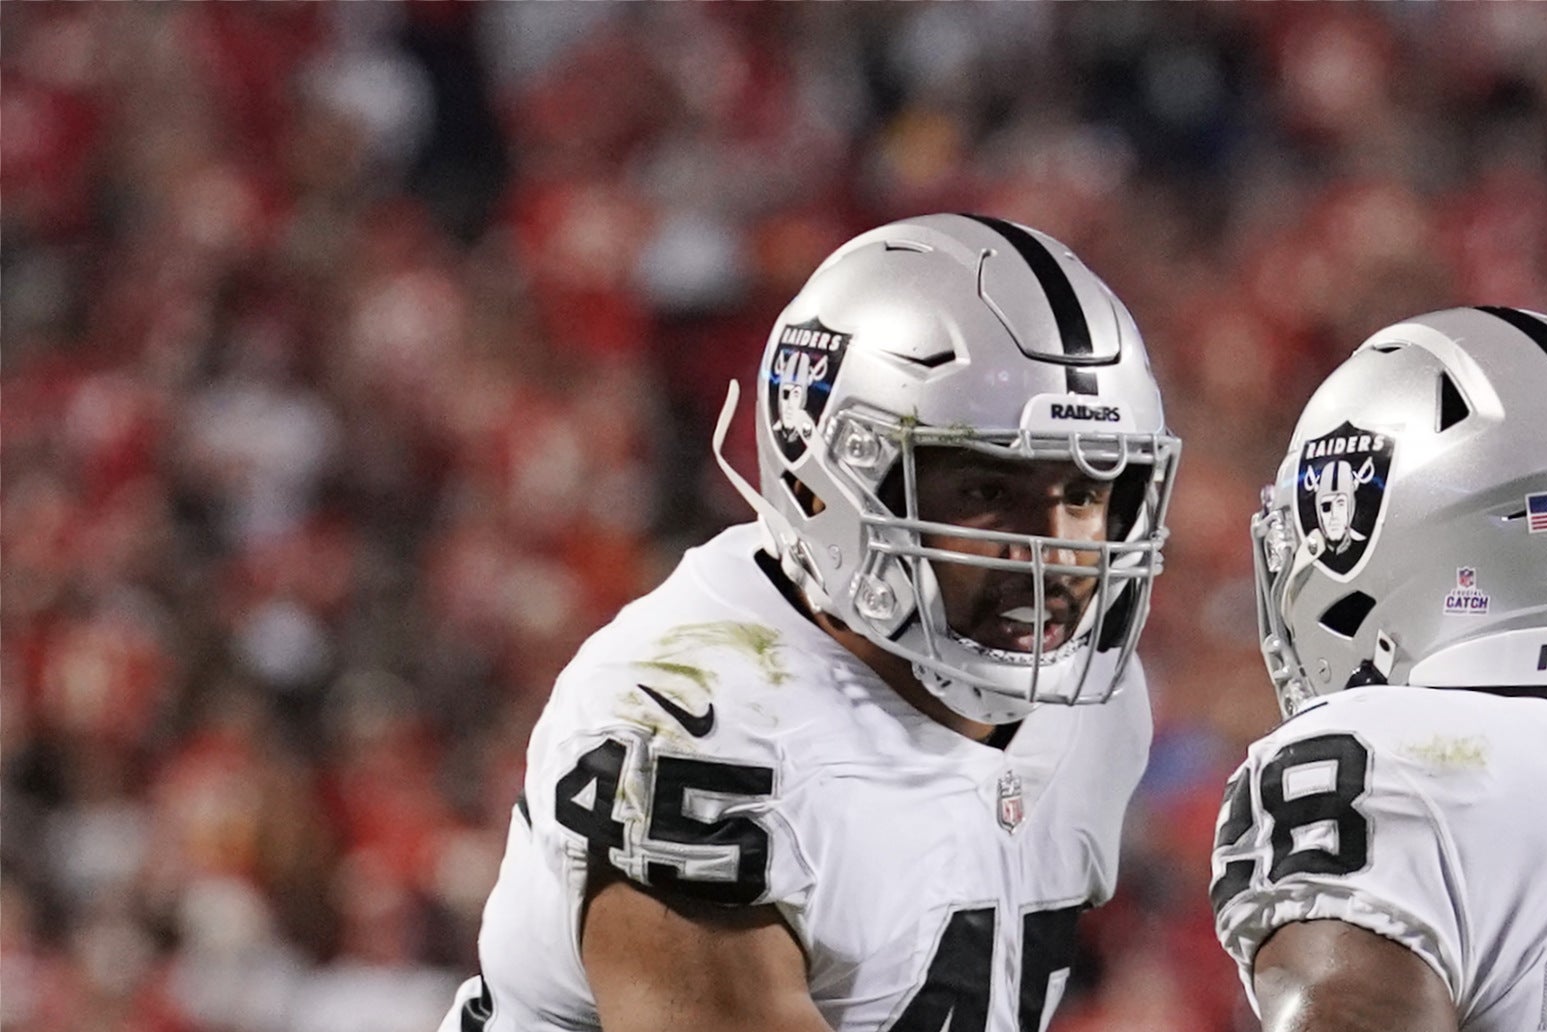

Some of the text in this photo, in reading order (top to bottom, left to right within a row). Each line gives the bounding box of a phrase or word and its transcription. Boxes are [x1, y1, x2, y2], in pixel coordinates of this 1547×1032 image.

[781, 328, 842, 351] RAIDERS
[1051, 404, 1120, 422] RAIDERS
[1306, 435, 1384, 459] RAIDERS
[1446, 596, 1488, 609] CATCH
[556, 738, 773, 907] 45
